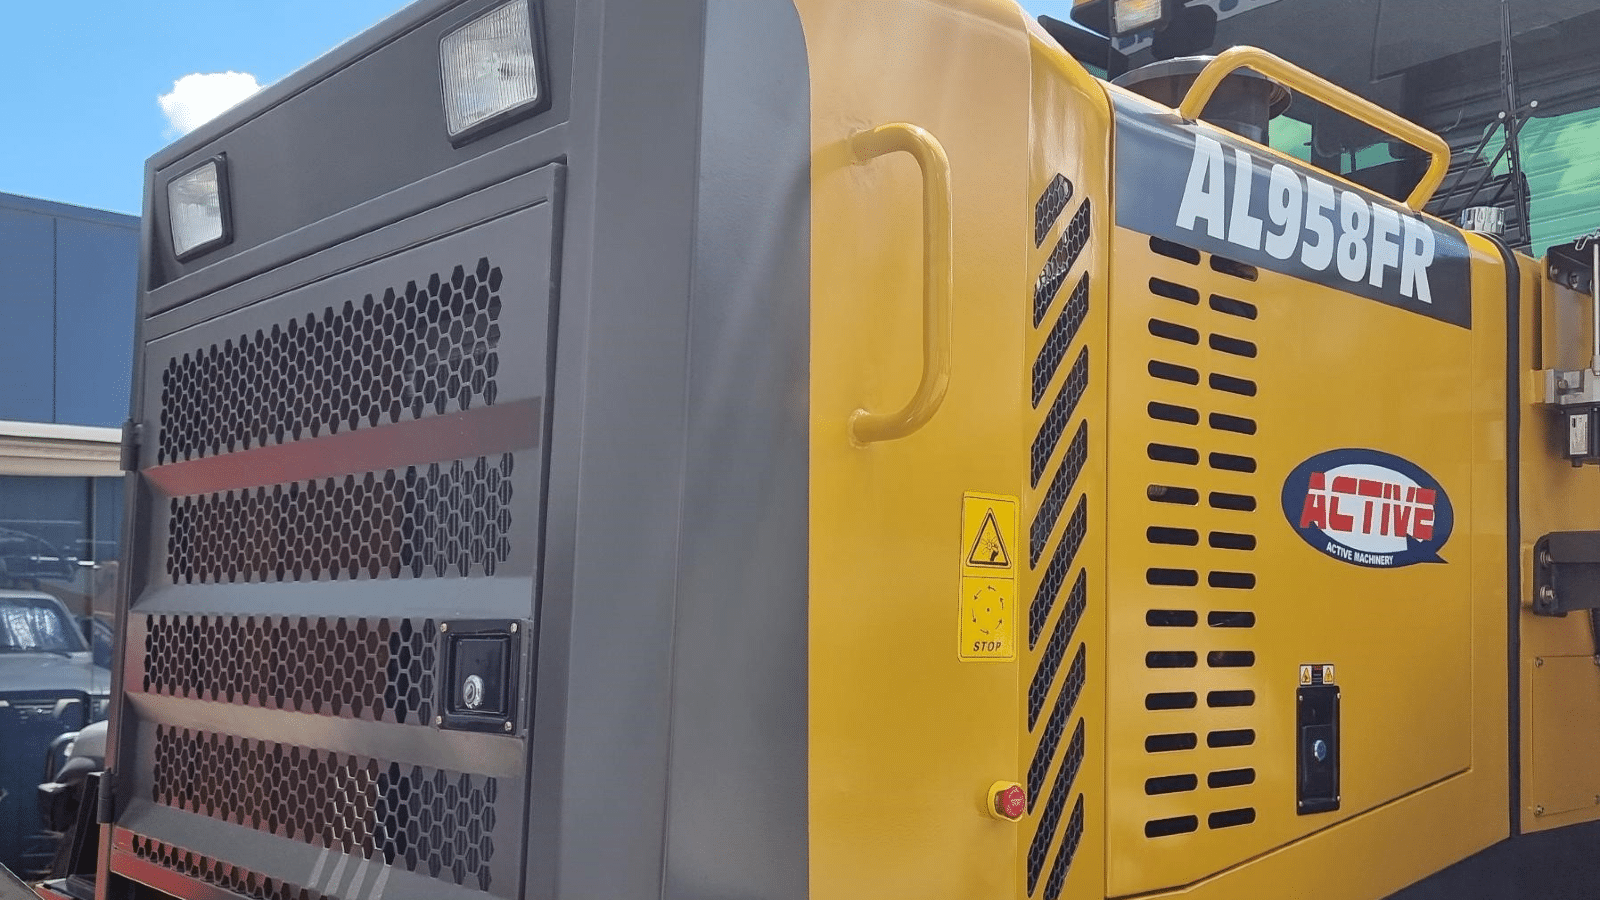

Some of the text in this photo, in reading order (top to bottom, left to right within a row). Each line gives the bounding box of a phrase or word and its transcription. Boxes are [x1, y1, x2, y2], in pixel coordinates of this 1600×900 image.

[1176, 133, 1435, 304] AL958FR
[1300, 471, 1437, 541] ACTIVE
[1326, 541, 1394, 566] ACTIVE MACHINERY
[973, 641, 1002, 652] STOP
